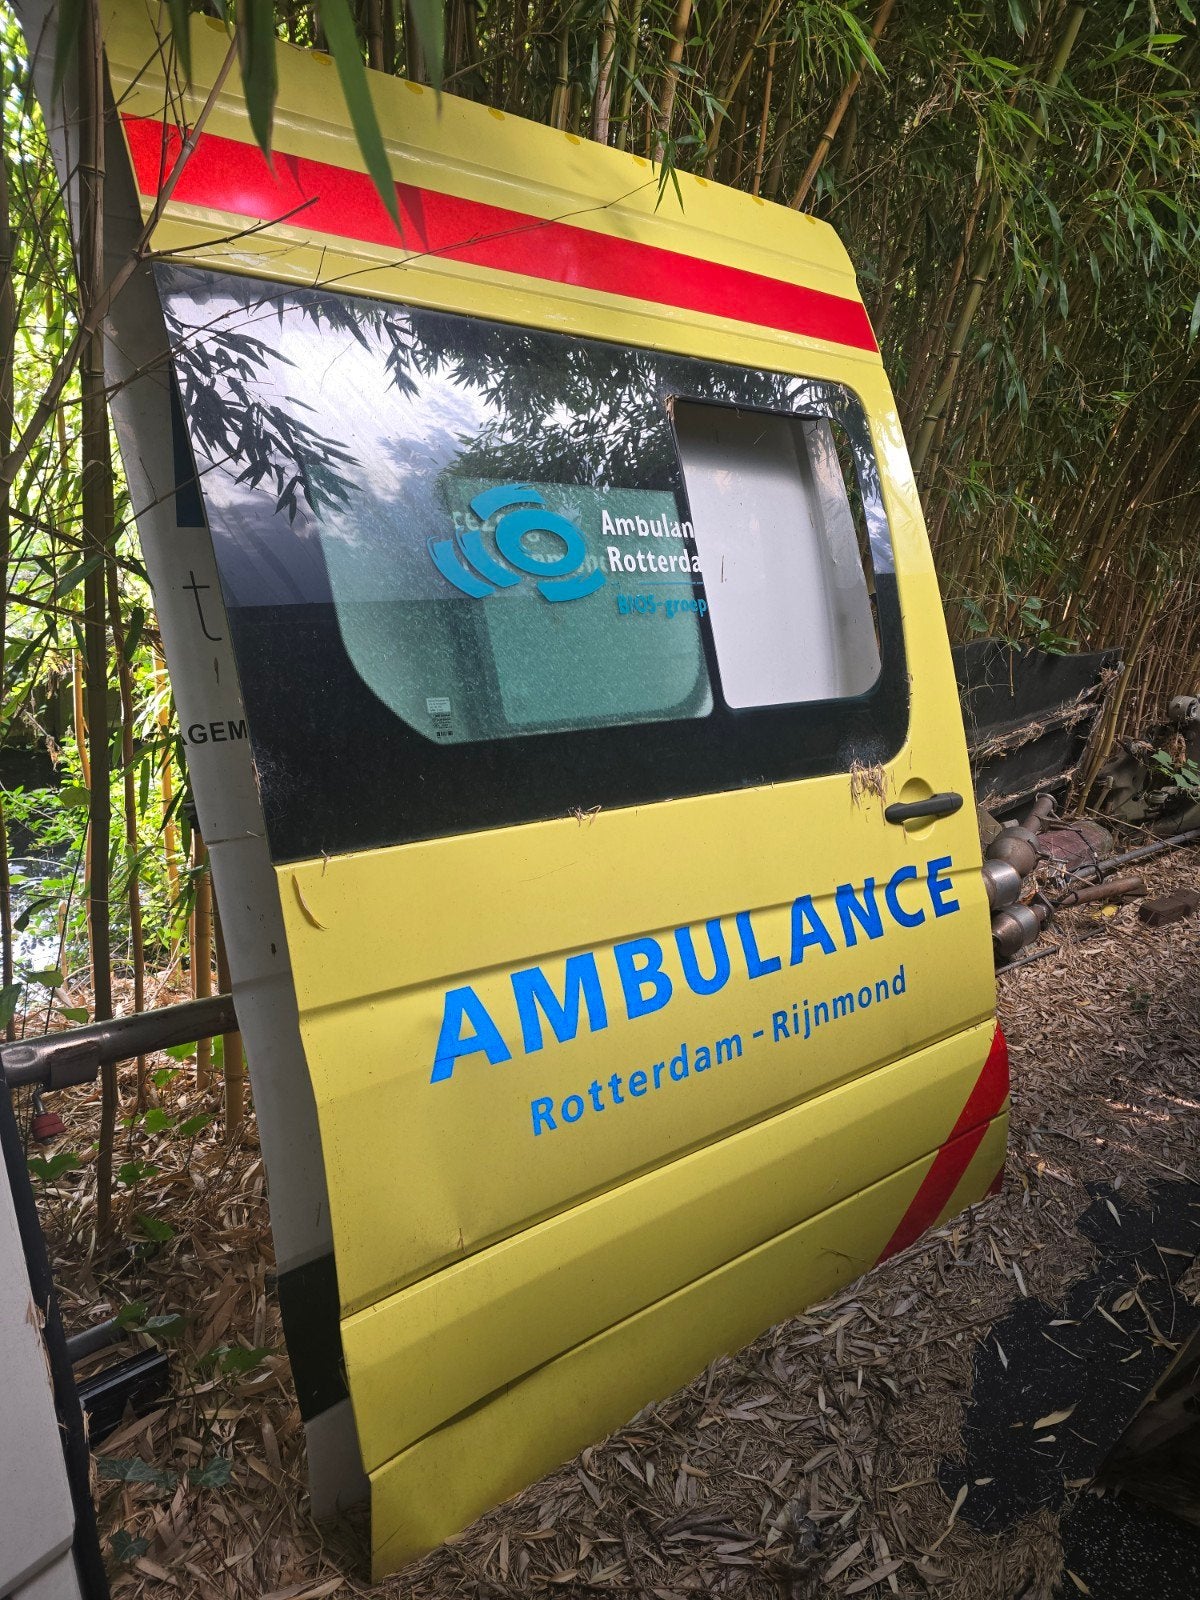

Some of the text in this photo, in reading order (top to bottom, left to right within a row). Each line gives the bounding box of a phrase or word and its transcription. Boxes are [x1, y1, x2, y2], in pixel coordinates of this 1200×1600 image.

[601, 509, 695, 539] Ambulan
[606, 545, 703, 573] Rotterda
[617, 594, 707, 618] BIOS-groep
[181, 719, 248, 745] GEM
[430, 855, 960, 1084] AMBULANCE
[530, 1034, 743, 1136] Rotterdam
[772, 965, 907, 1042] Rijnmond
